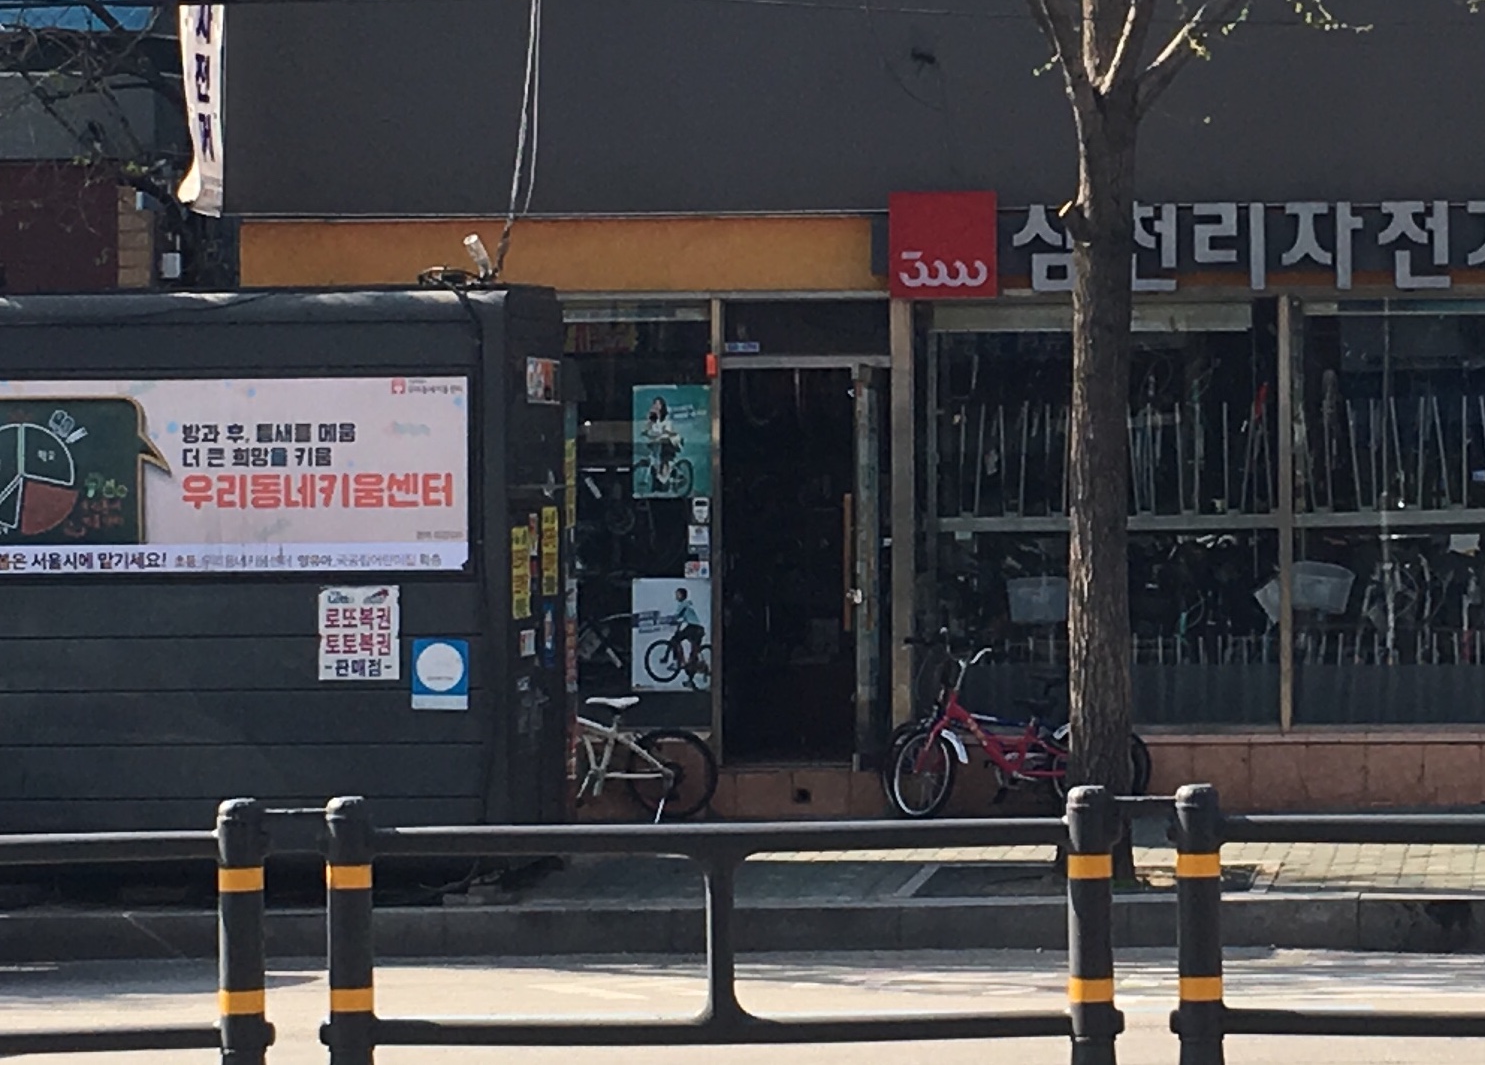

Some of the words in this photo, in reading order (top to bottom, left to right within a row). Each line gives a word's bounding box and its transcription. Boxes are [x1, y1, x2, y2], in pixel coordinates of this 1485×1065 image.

[182, 423, 220, 443] 방과
[318, 423, 356, 443] 메움
[182, 448, 200, 467] 더
[207, 449, 225, 467] 큰
[232, 448, 287, 467] 희망을
[294, 448, 332, 467] 키움
[182, 473, 454, 510] 우리동네키움센터
[31, 551, 94, 570] 서울시에
[98, 551, 168, 570] 맡기세요!
[324, 606, 391, 630] 로또복권
[324, 632, 391, 656] 토토복권
